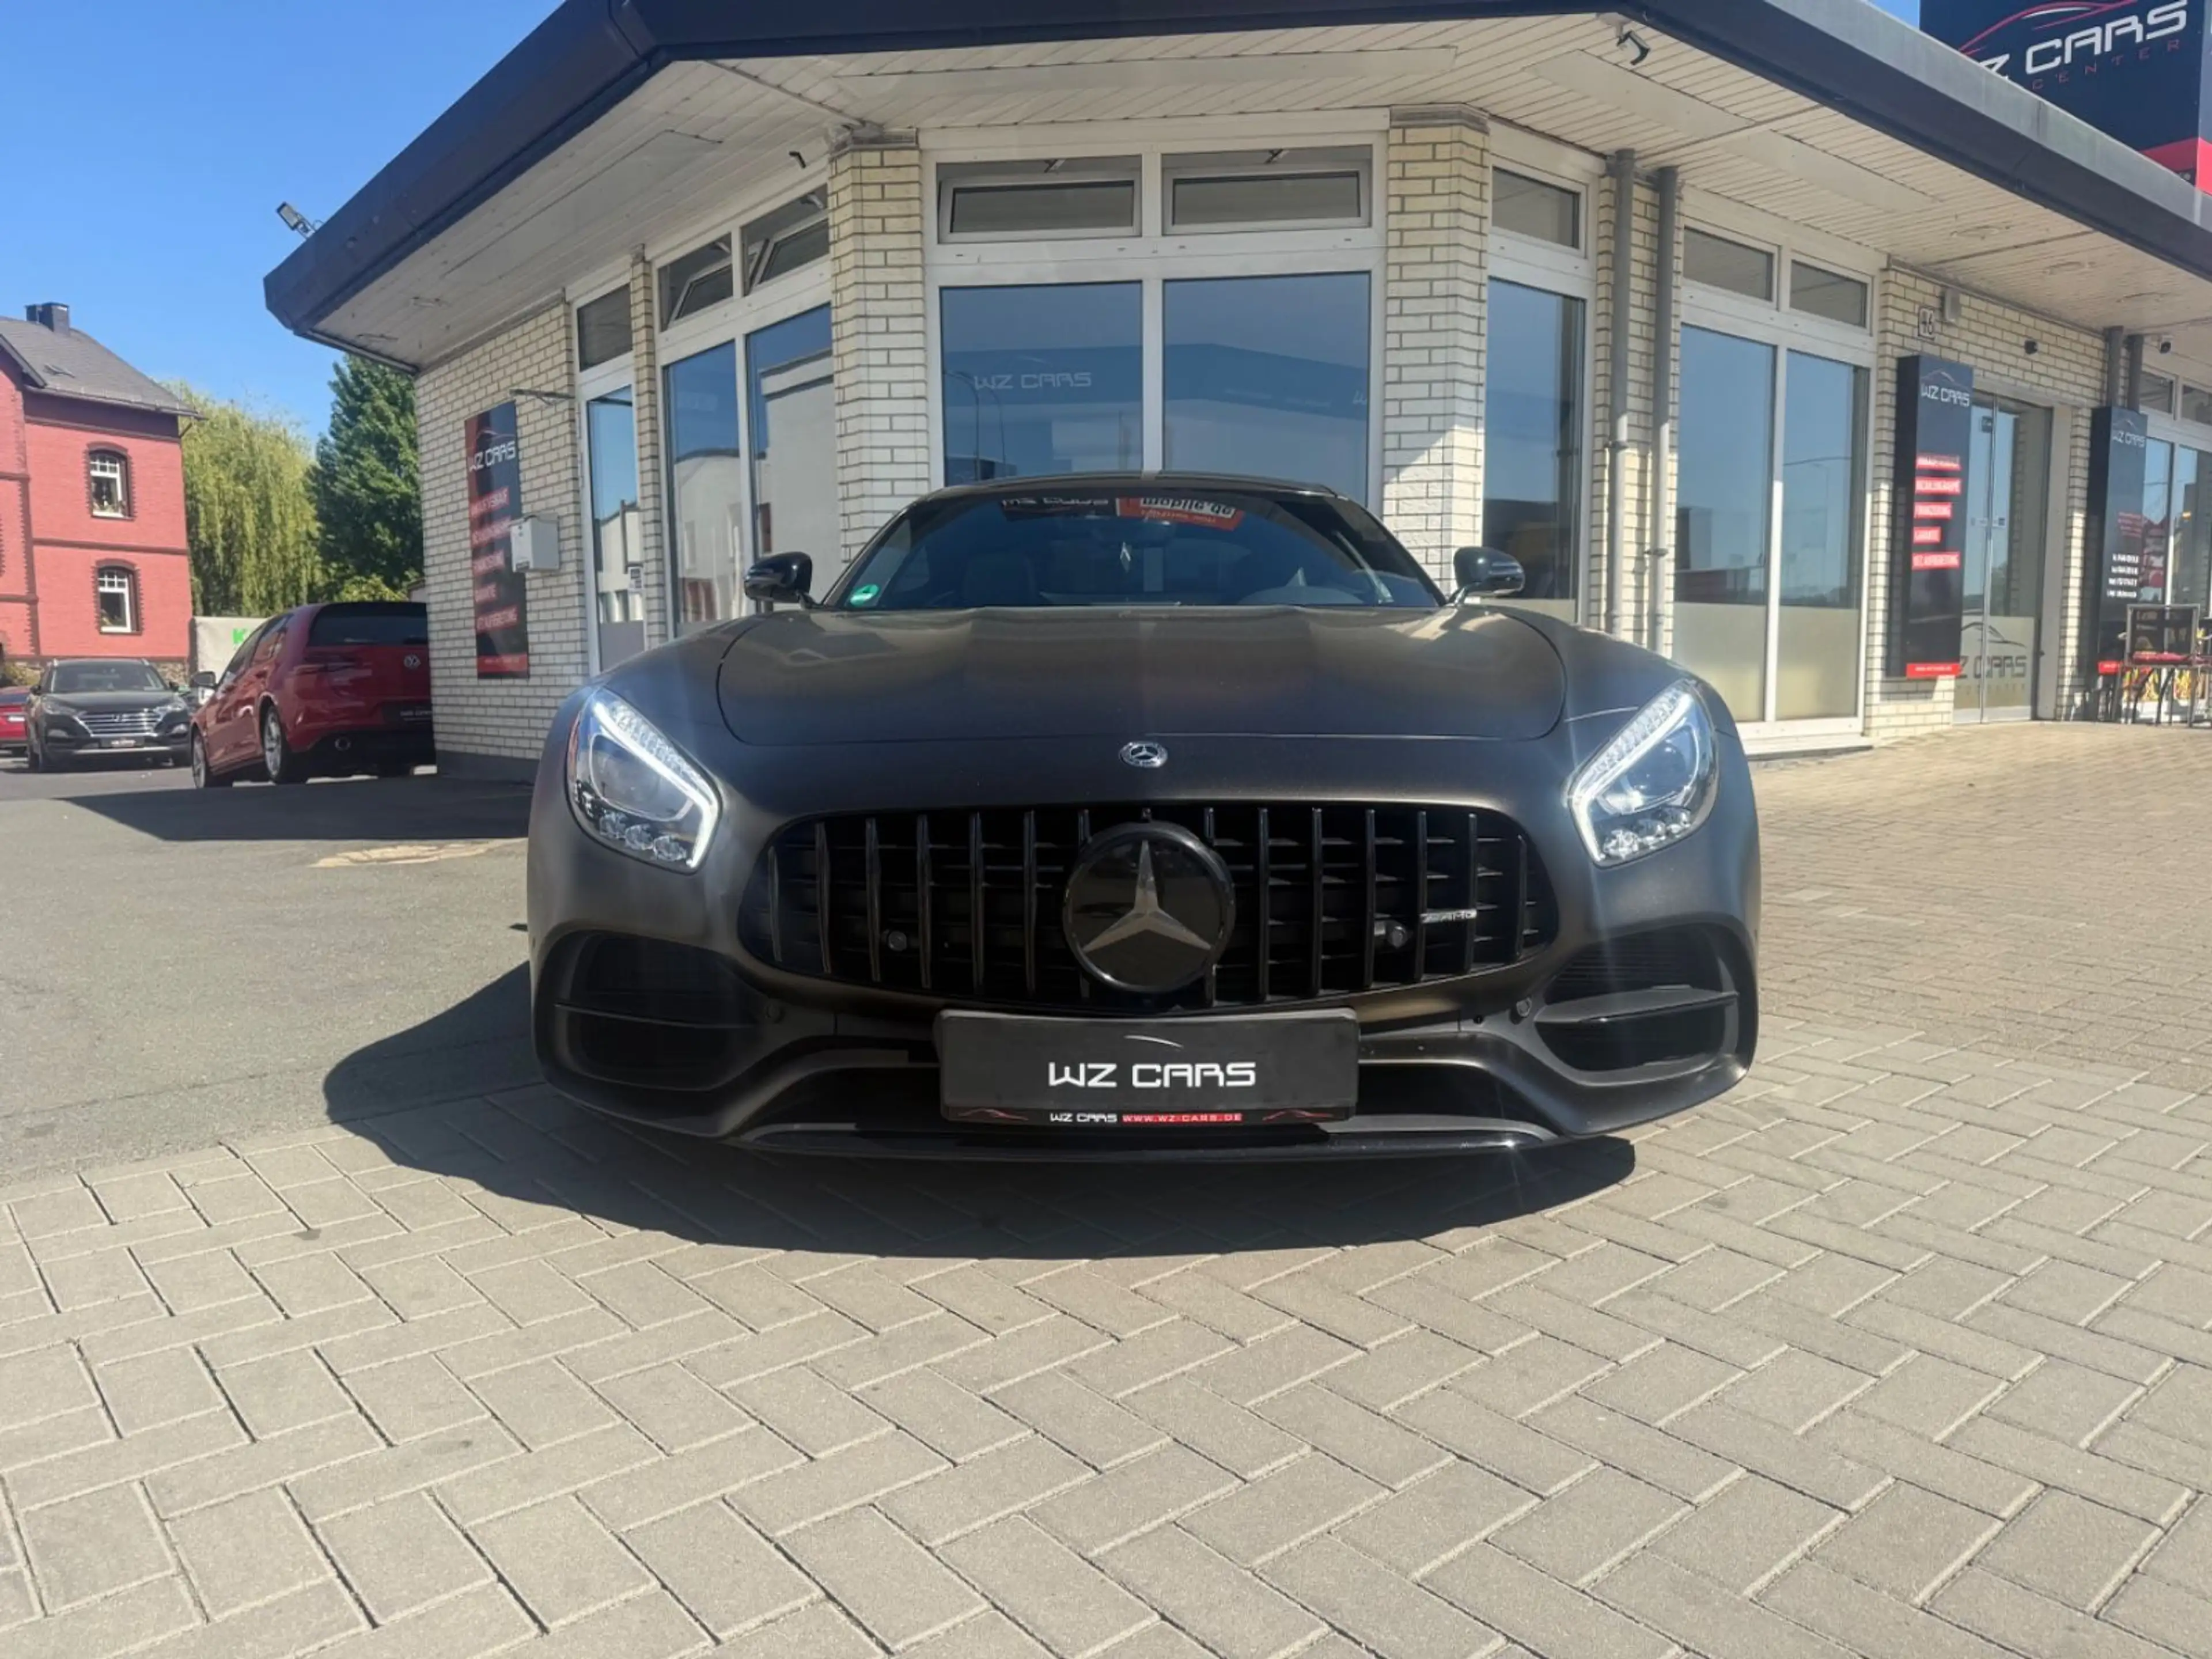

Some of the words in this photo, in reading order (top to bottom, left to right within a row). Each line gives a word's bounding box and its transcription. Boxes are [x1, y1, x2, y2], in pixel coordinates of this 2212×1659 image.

[2025, 0, 2188, 74] CARS
[2032, 39, 2180, 90] CENTER
[974, 374, 1014, 391] WZ
[1021, 372, 1092, 389] CARS
[1941, 387, 1969, 407] CARS
[485, 441, 516, 467] CARS
[1048, 1062, 1117, 1088] WZ
[1132, 1062, 1256, 1088] CARS
[1050, 1112, 1073, 1123] WZ
[1077, 1113, 1118, 1123] CARS
